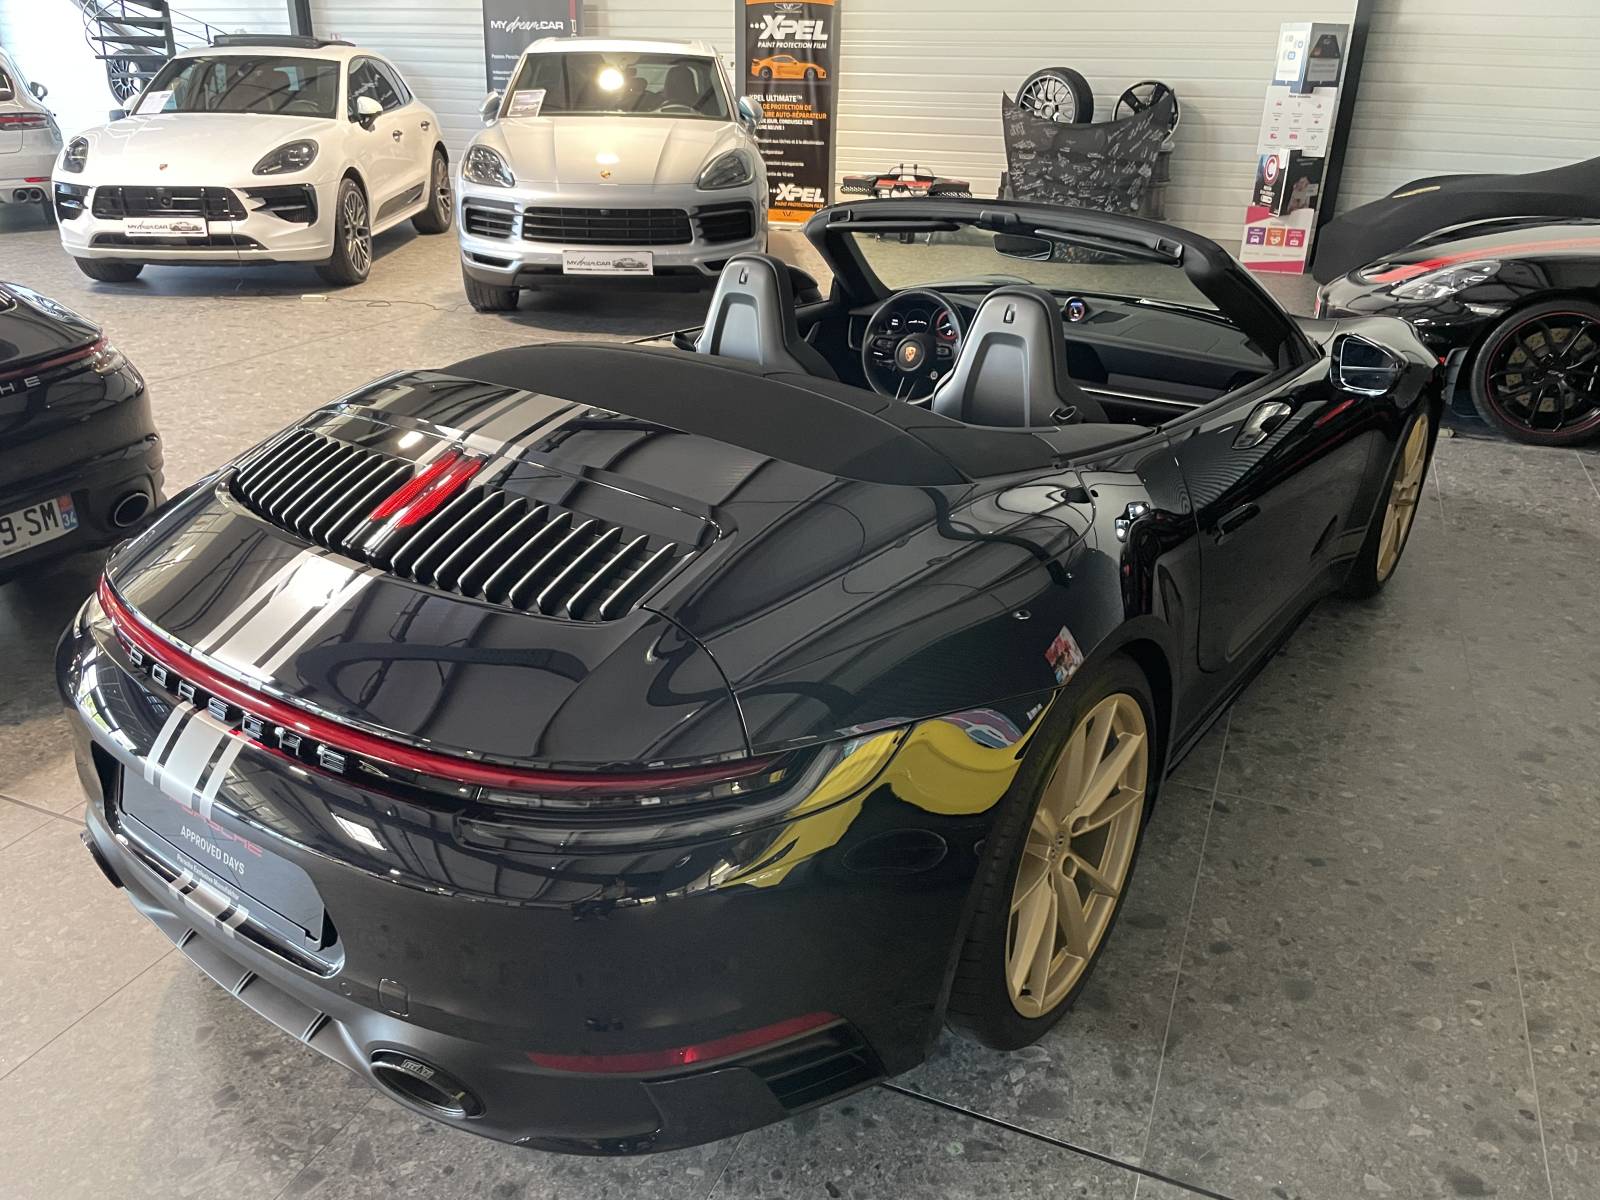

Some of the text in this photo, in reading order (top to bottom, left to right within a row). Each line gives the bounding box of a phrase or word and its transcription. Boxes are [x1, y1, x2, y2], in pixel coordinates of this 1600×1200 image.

[759, 14, 828, 40] XPEL
[776, 41, 812, 49] PROTECTION
[771, 103, 804, 111] PROTECTION
[775, 183, 824, 202] XPEL
[130, 644, 346, 774] PORSCHE
[180, 825, 222, 860] APPROVED
[223, 852, 245, 875] DAYS
